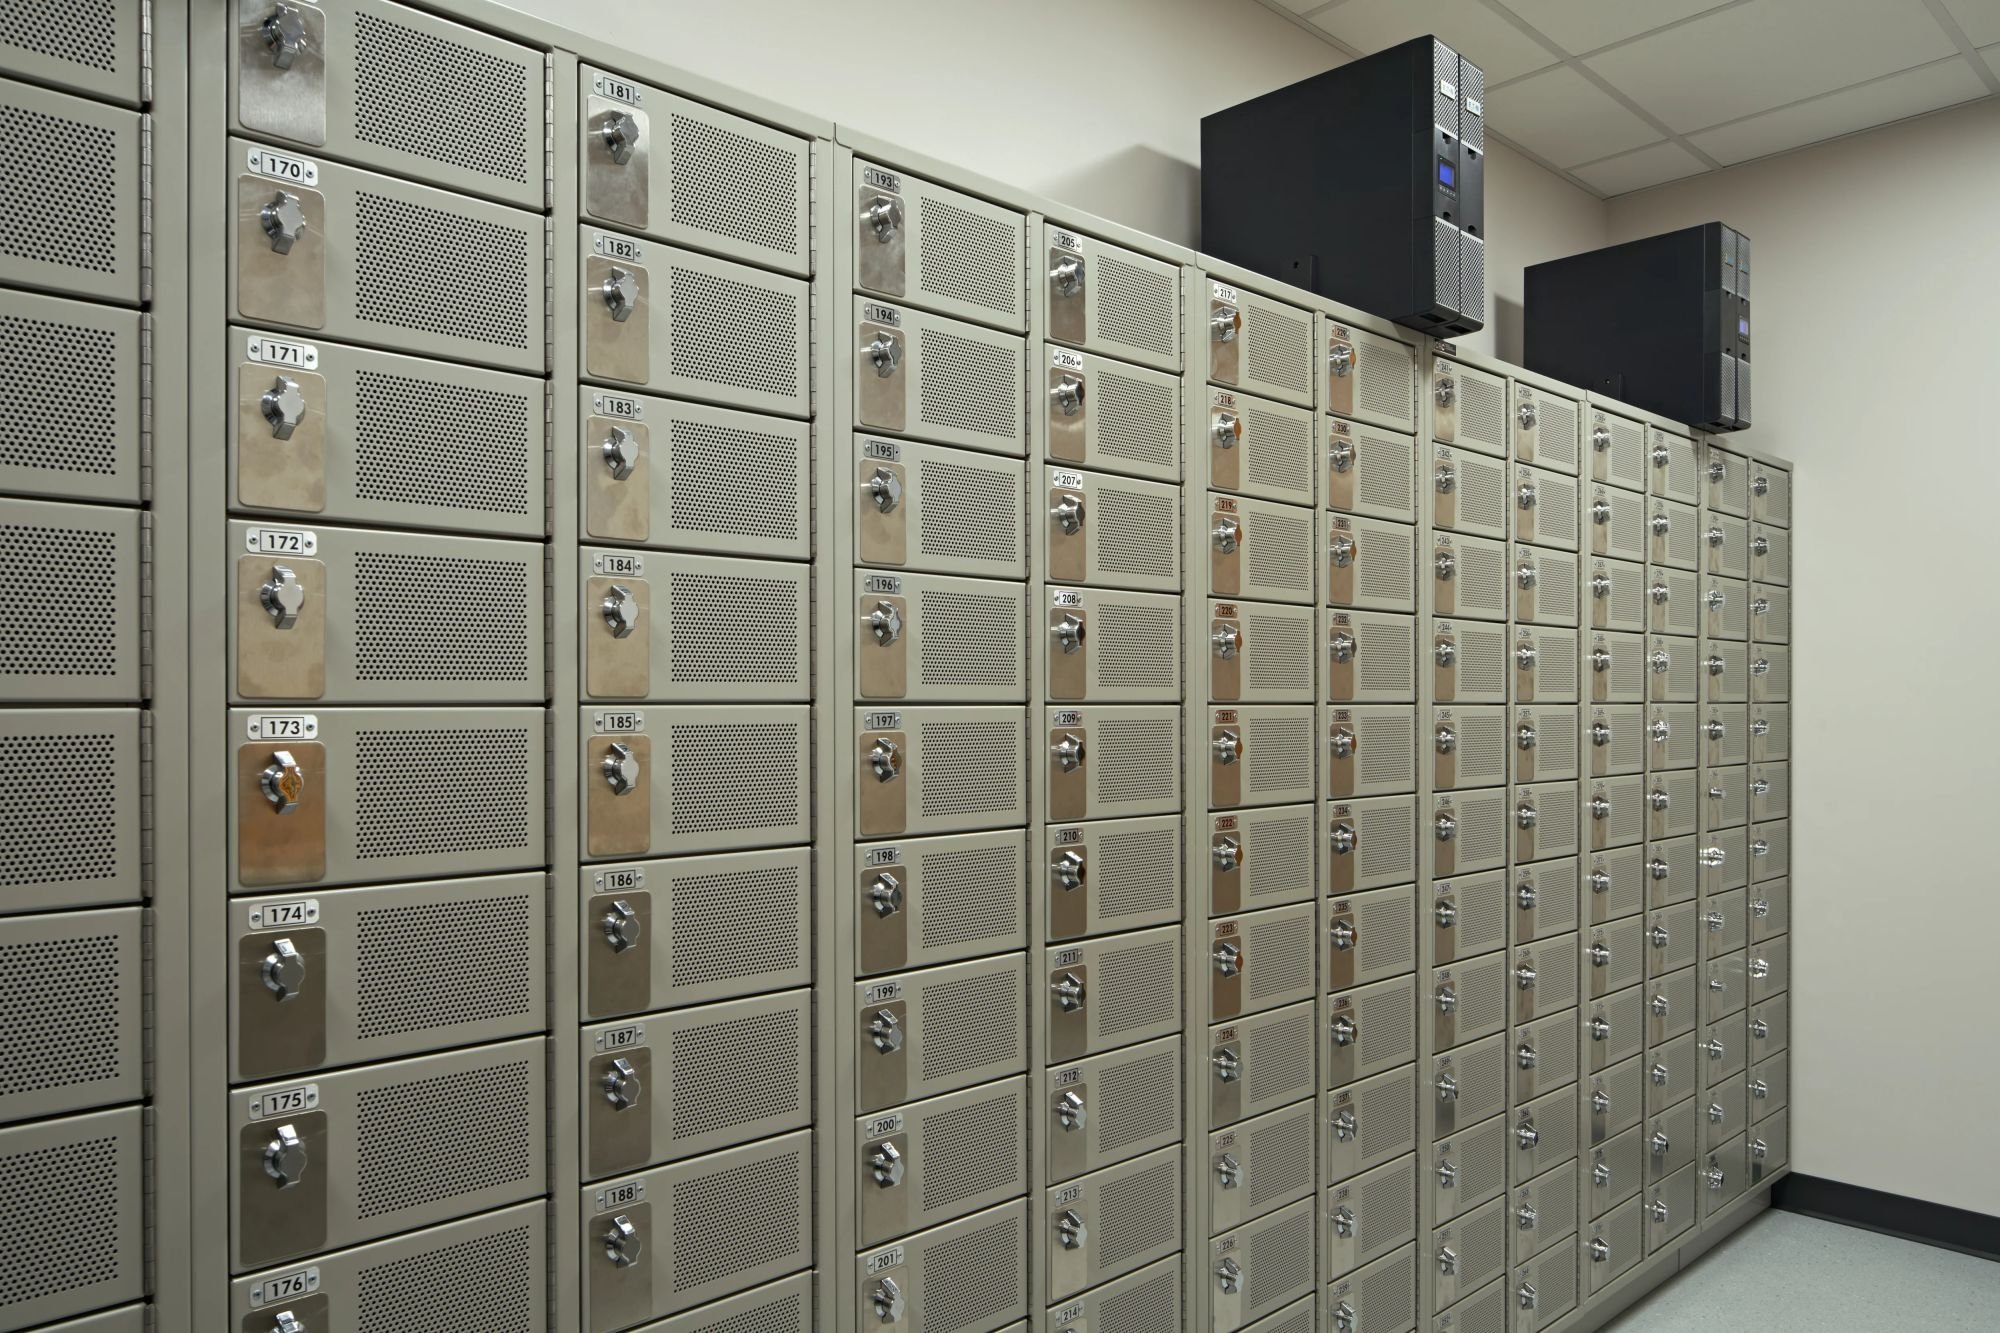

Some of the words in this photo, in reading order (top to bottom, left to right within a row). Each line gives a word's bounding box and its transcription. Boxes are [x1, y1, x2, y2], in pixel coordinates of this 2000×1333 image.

[609, 83, 630, 100] 181
[270, 158, 300, 178] 170
[876, 172, 892, 187] 193
[1061, 235, 1075, 248] 205
[609, 241, 632, 257] 182
[1220, 289, 1231, 299] 217
[875, 308, 892, 322] 194
[270, 345, 298, 363] 171
[1061, 354, 1075, 366] 206
[1220, 395, 1231, 405] 218
[609, 400, 632, 415] 183
[875, 445, 892, 457] 195
[1061, 475, 1075, 486] 207
[1221, 499, 1232, 509] 219
[269, 535, 299, 551] 172
[609, 559, 632, 572] 184
[876, 579, 893, 590] 196
[1062, 593, 1075, 604] 208
[1221, 606, 1232, 615] 220
[610, 716, 632, 729] 185
[876, 715, 893, 726] 197
[1062, 713, 1075, 723] 209
[1222, 712, 1232, 721] 221
[270, 721, 300, 735] 173
[1221, 818, 1232, 828] 222
[1063, 831, 1076, 841] 210
[876, 851, 893, 862] 198
[610, 874, 633, 887] 186
[271, 906, 302, 922] 174
[1222, 924, 1233, 933] 223
[1062, 952, 1075, 963] 211
[877, 987, 894, 999] 199
[611, 1031, 634, 1045] 187
[1222, 1030, 1233, 1039] 224
[1063, 1071, 1076, 1082] 212
[271, 1093, 302, 1111] 175
[877, 1119, 894, 1133] 200
[1222, 1135, 1233, 1145] 225
[611, 1187, 634, 1204] 188
[1063, 1188, 1077, 1202] 213
[1222, 1239, 1233, 1250] 226
[878, 1253, 894, 1269] 201
[272, 1277, 303, 1296] 176
[1063, 1308, 1077, 1321] 214
